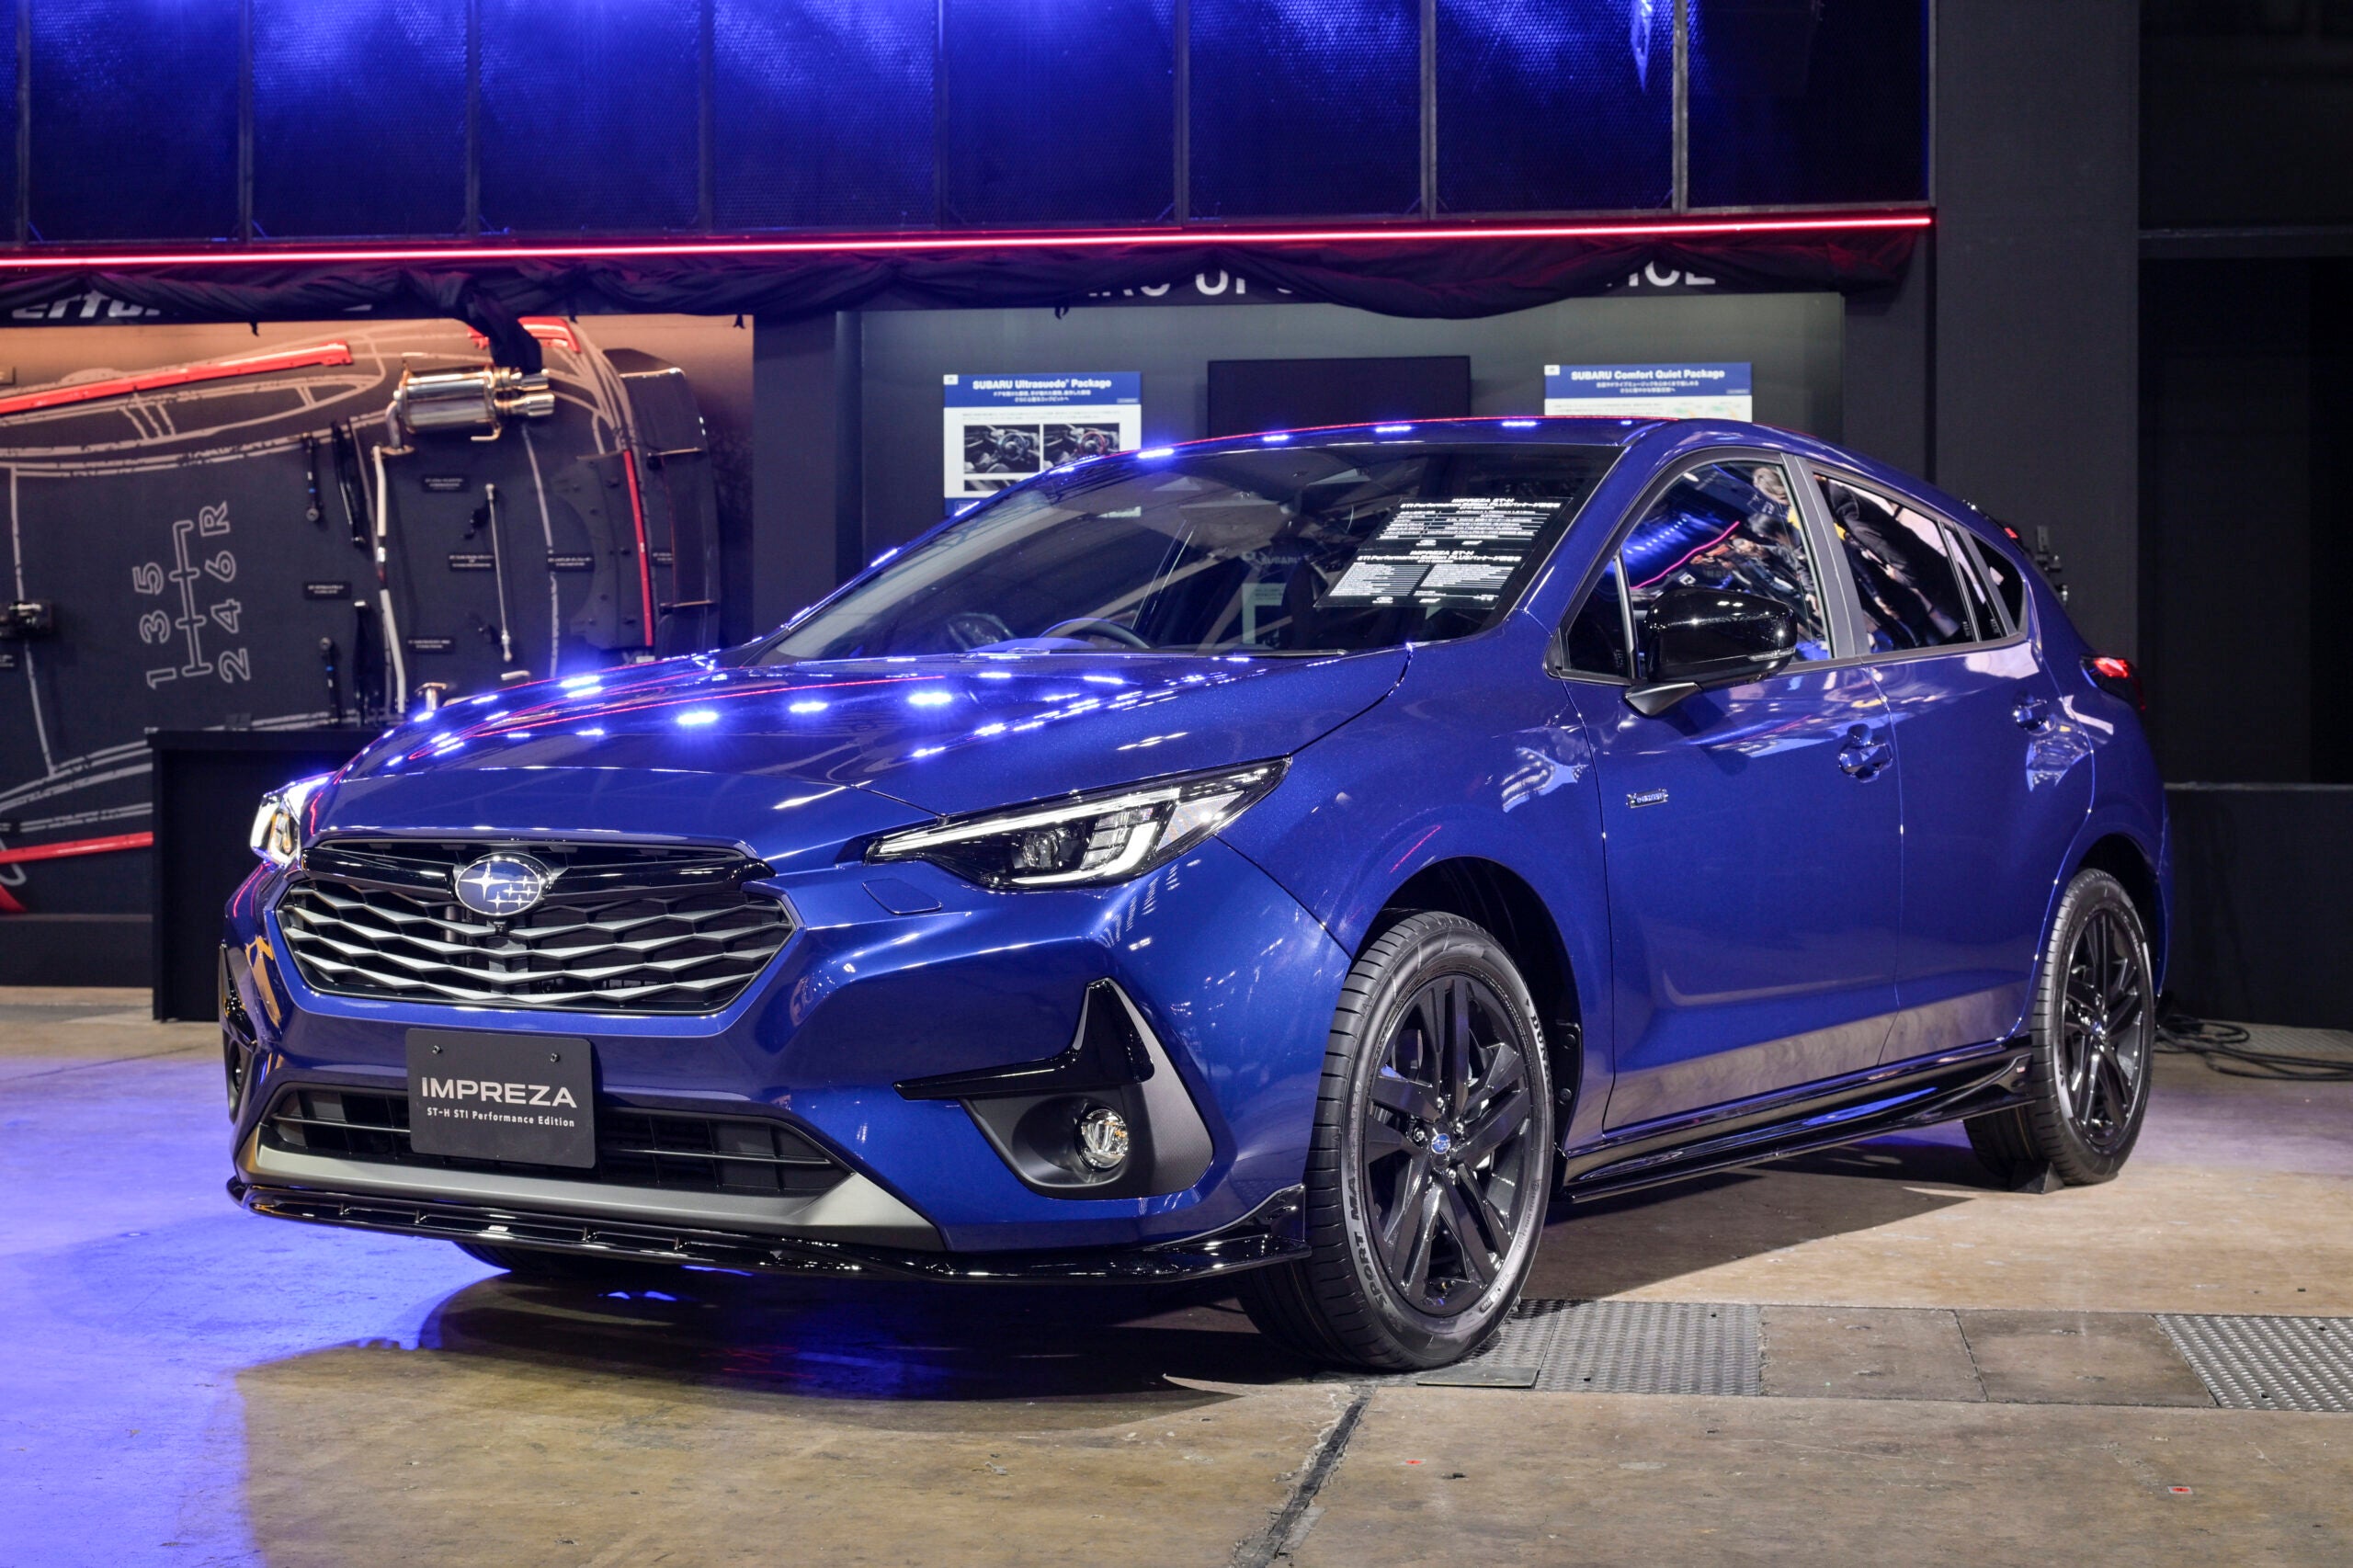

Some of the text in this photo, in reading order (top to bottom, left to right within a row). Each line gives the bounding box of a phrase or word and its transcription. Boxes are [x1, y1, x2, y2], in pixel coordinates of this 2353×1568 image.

[972, 380, 1013, 390] SUBARU
[1071, 379, 1111, 390] Package
[1571, 369, 1725, 381] SUBARU Comfort Quiet Package
[199, 500, 251, 684] 2 4 6 R
[132, 562, 177, 689] 1 3 5
[421, 1076, 578, 1108] IMPREZA
[426, 1107, 575, 1128] ST-H STI Performance Edition
[1354, 1231, 1387, 1311] SPORT
